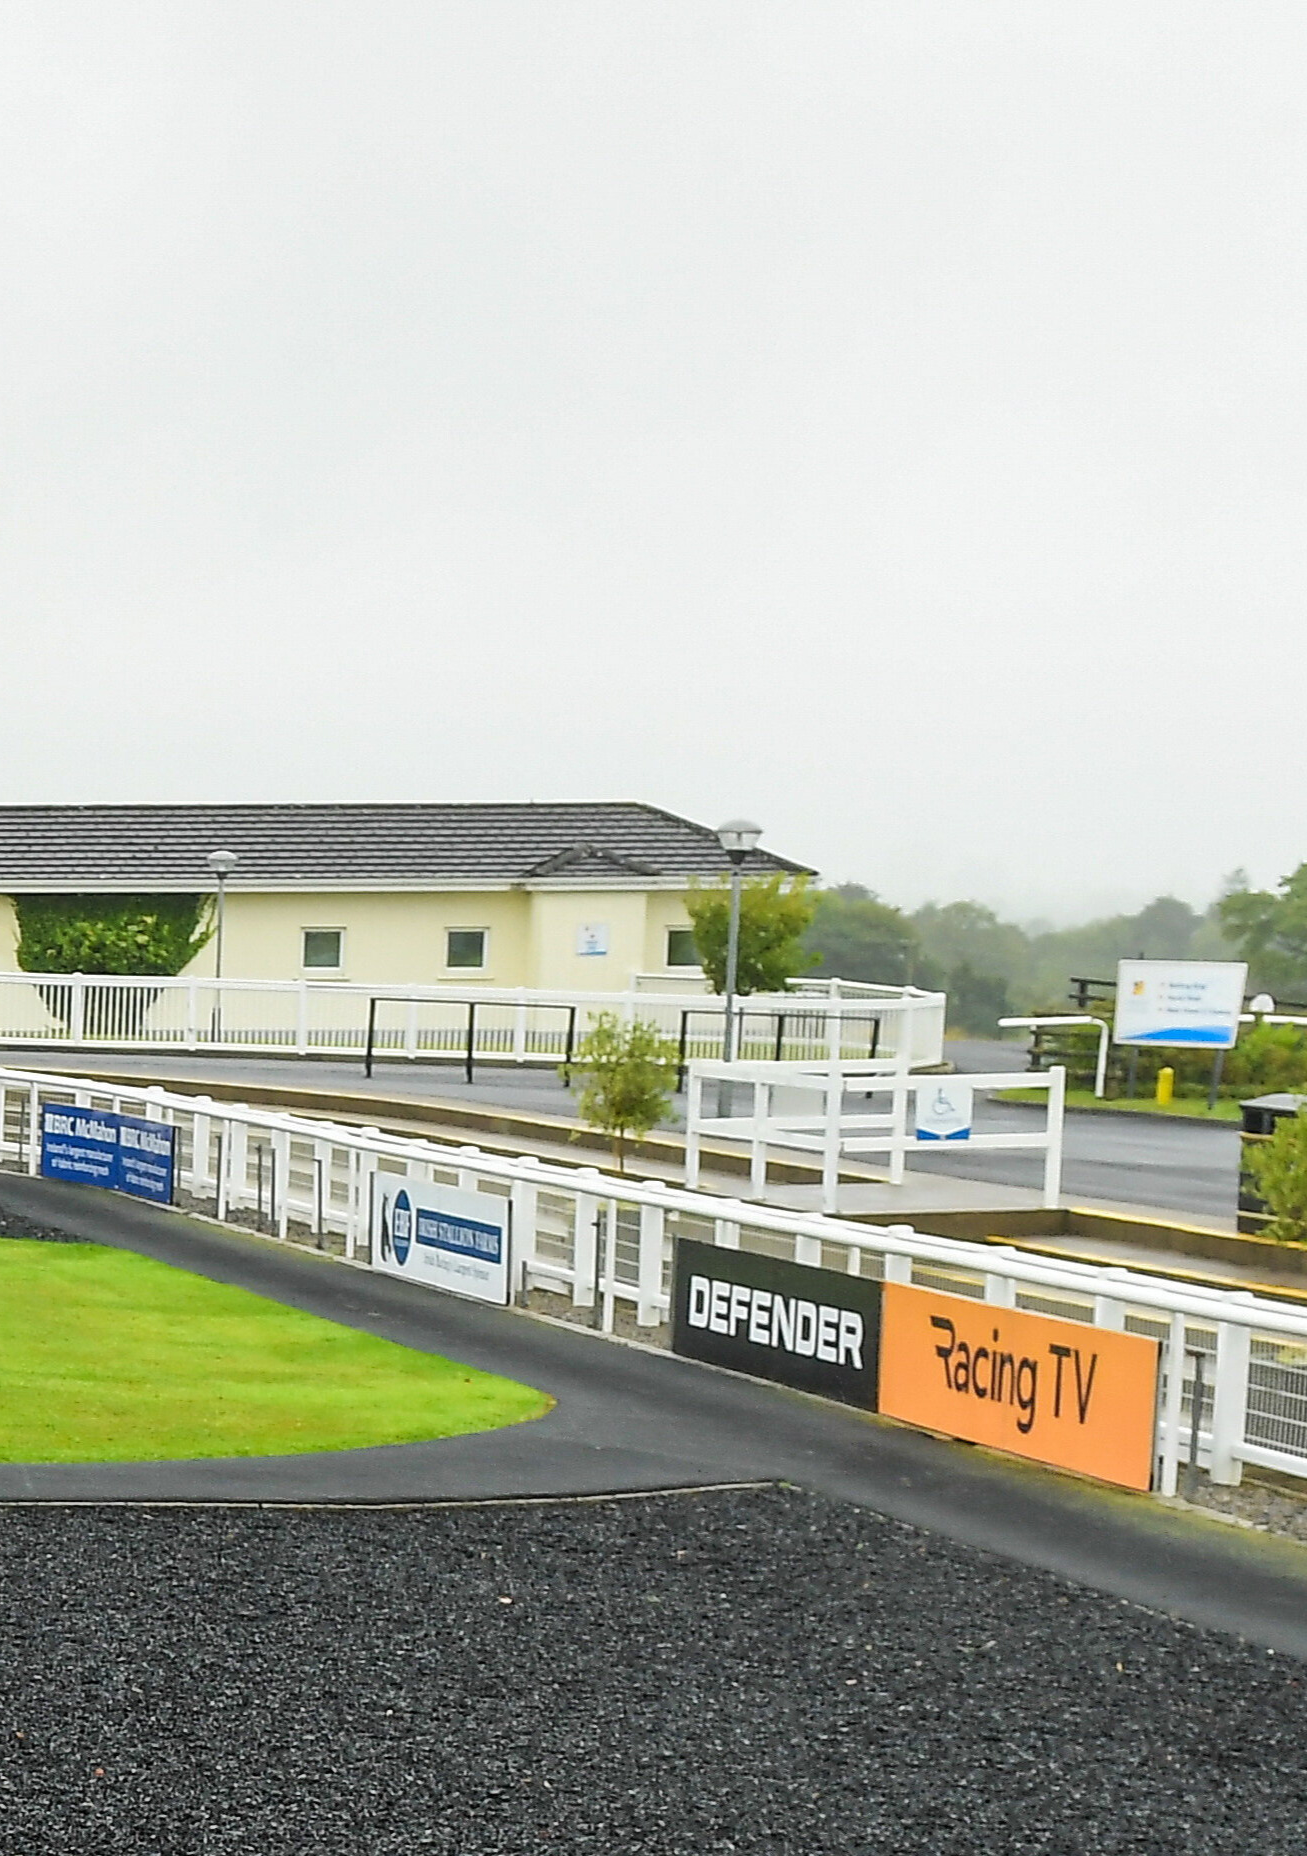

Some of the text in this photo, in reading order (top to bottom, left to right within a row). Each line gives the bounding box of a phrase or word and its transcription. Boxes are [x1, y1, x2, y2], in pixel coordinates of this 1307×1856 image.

[53, 1114, 74, 1136] BRC
[688, 1275, 864, 1370] DEFENDER
[930, 1315, 1097, 1434] Racing TV
